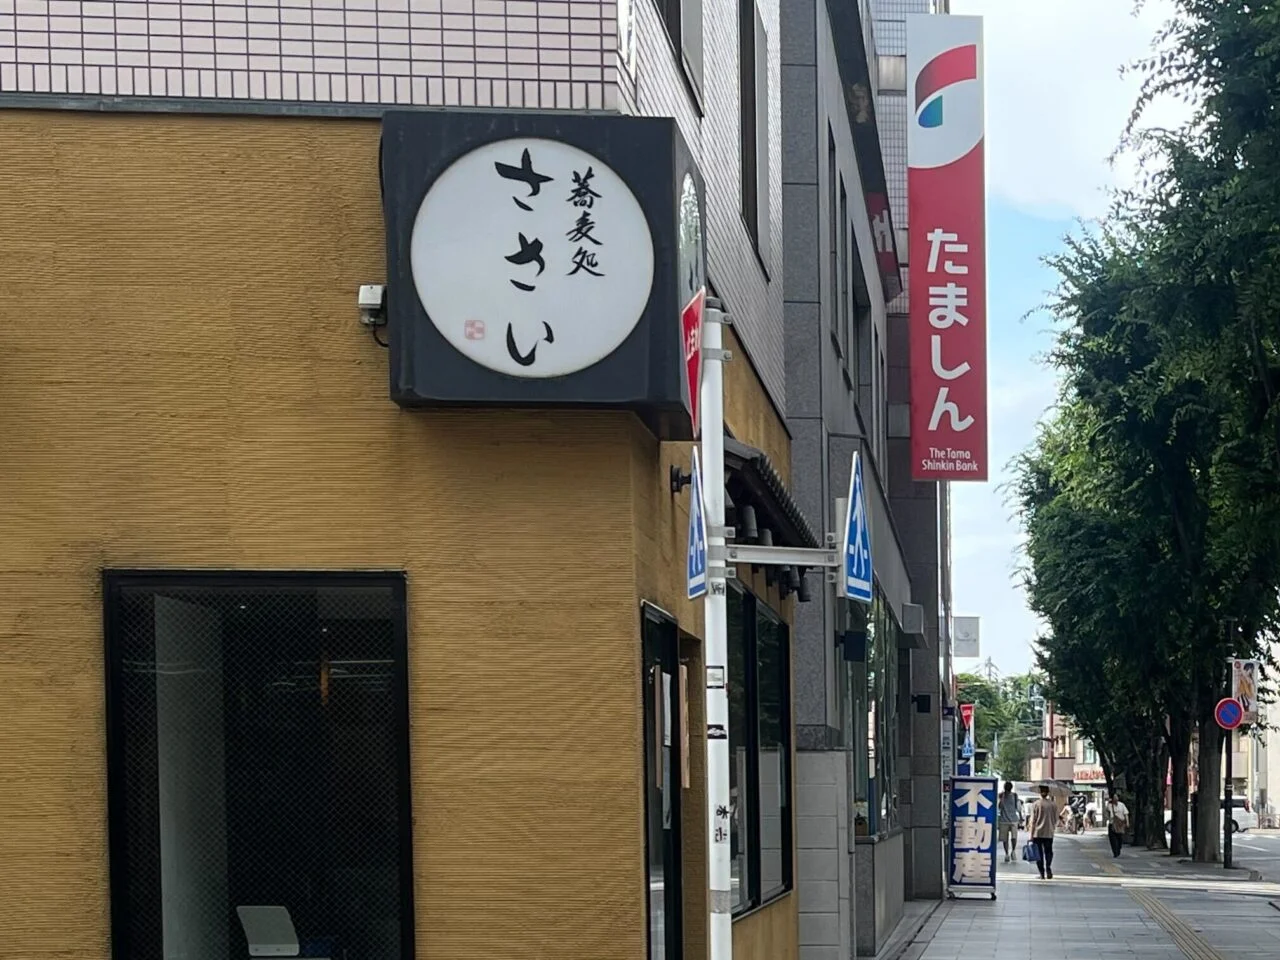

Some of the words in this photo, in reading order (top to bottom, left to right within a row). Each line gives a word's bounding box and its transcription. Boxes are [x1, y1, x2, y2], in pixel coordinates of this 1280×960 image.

[566, 166, 606, 277] 蕎麦処
[926, 228, 974, 433] たましん
[921, 459, 955, 471] Shinkin
[956, 460, 979, 471] Bank
[929, 447, 946, 459] The
[946, 447, 971, 459] Tama
[952, 781, 994, 884] 不動産
